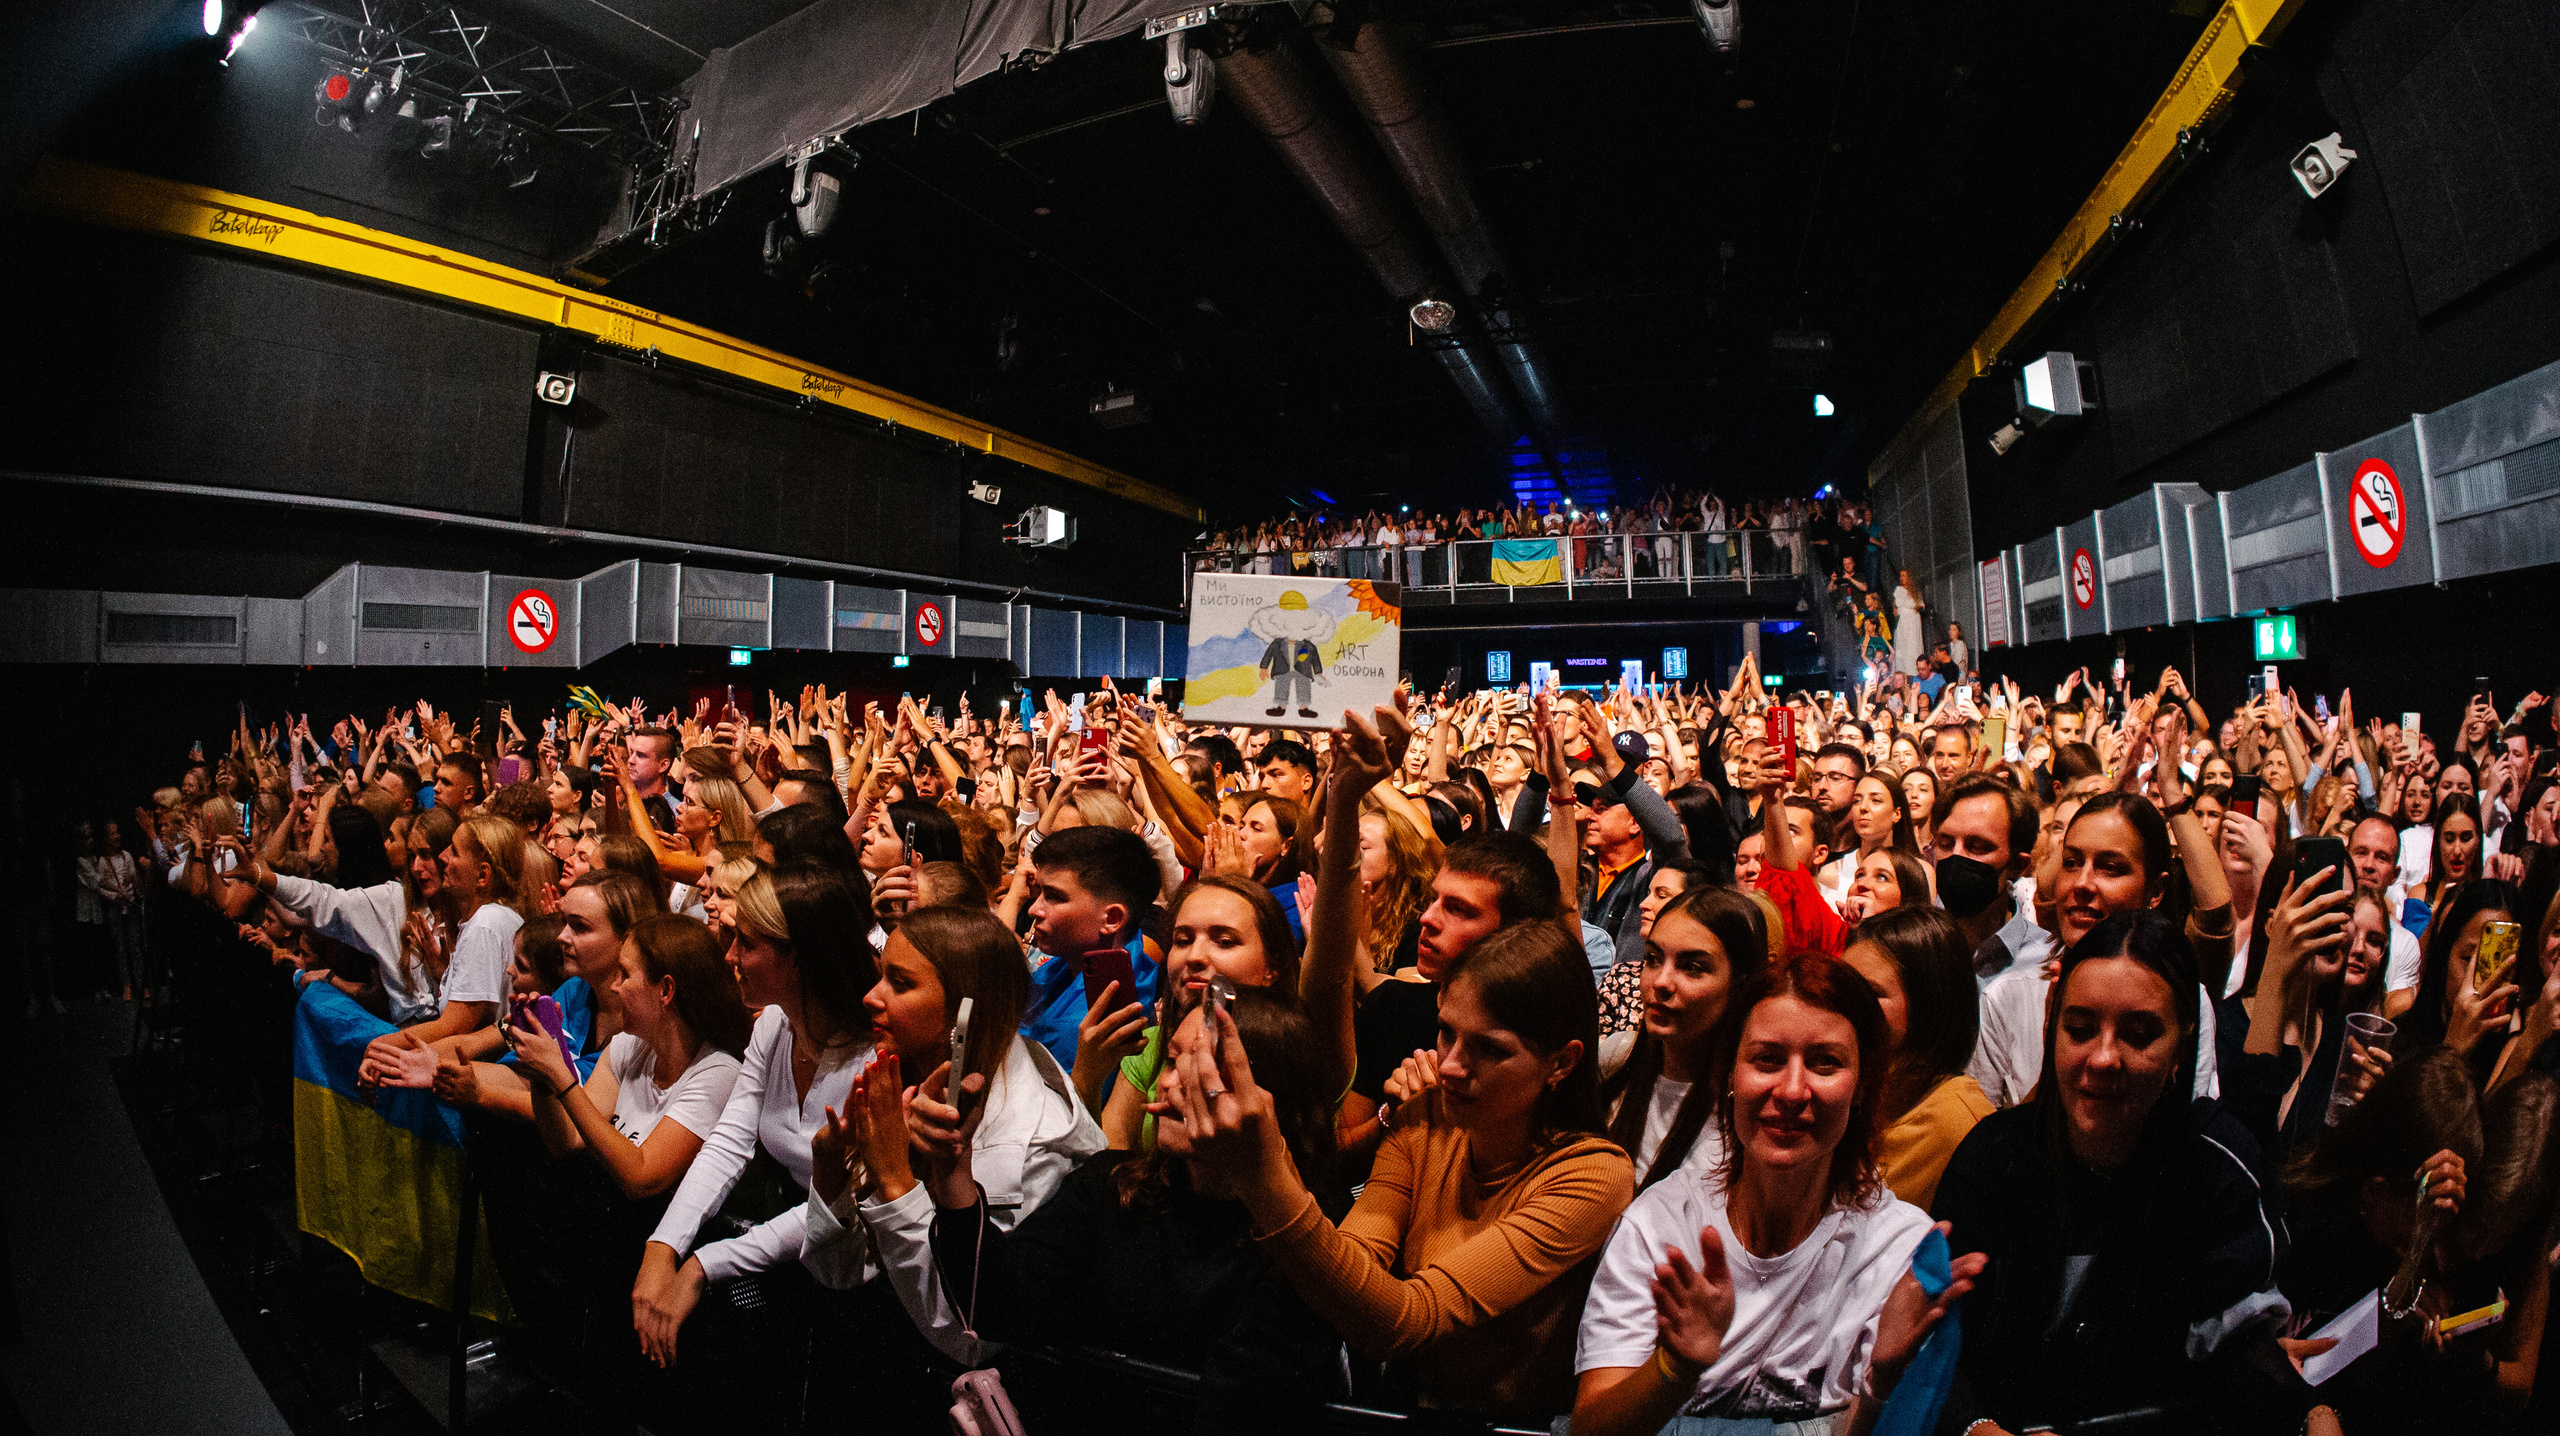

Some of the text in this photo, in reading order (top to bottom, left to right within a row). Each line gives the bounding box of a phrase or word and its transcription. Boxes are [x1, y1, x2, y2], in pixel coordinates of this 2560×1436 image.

[1335, 641, 1369, 660] ART
[1333, 665, 1385, 678] ОБОРОНА
[1618, 733, 1632, 746] NY
